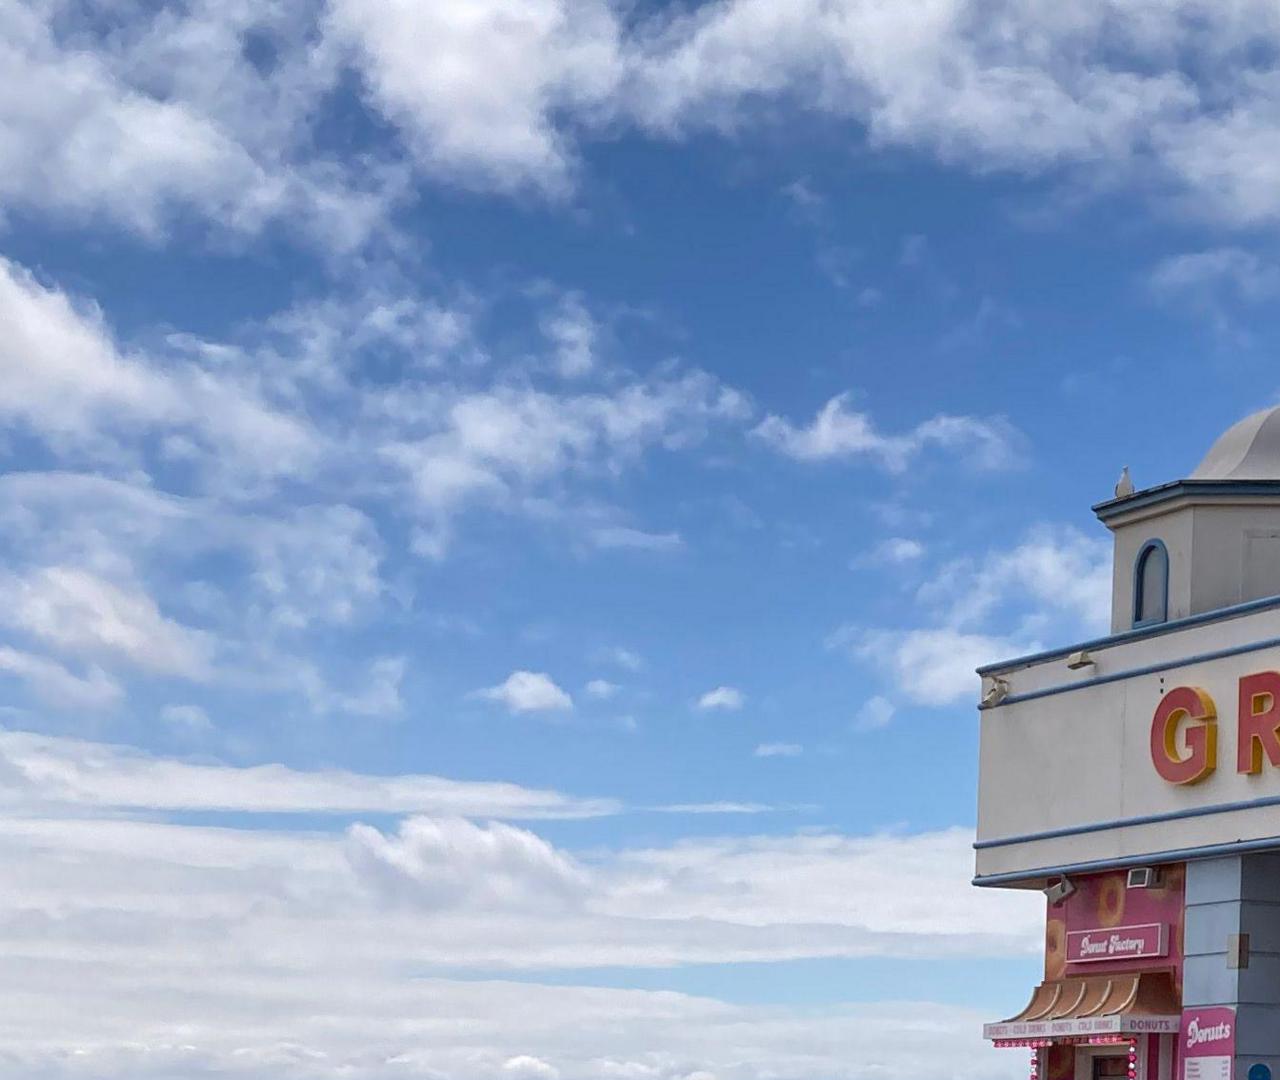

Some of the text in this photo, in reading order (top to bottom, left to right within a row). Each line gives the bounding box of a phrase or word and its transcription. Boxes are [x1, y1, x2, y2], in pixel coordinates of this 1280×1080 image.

[1080, 934, 1144, 957] Donut Factory
[1130, 1020, 1170, 1030] DONUTS
[1187, 1018, 1231, 1048] Donuts
